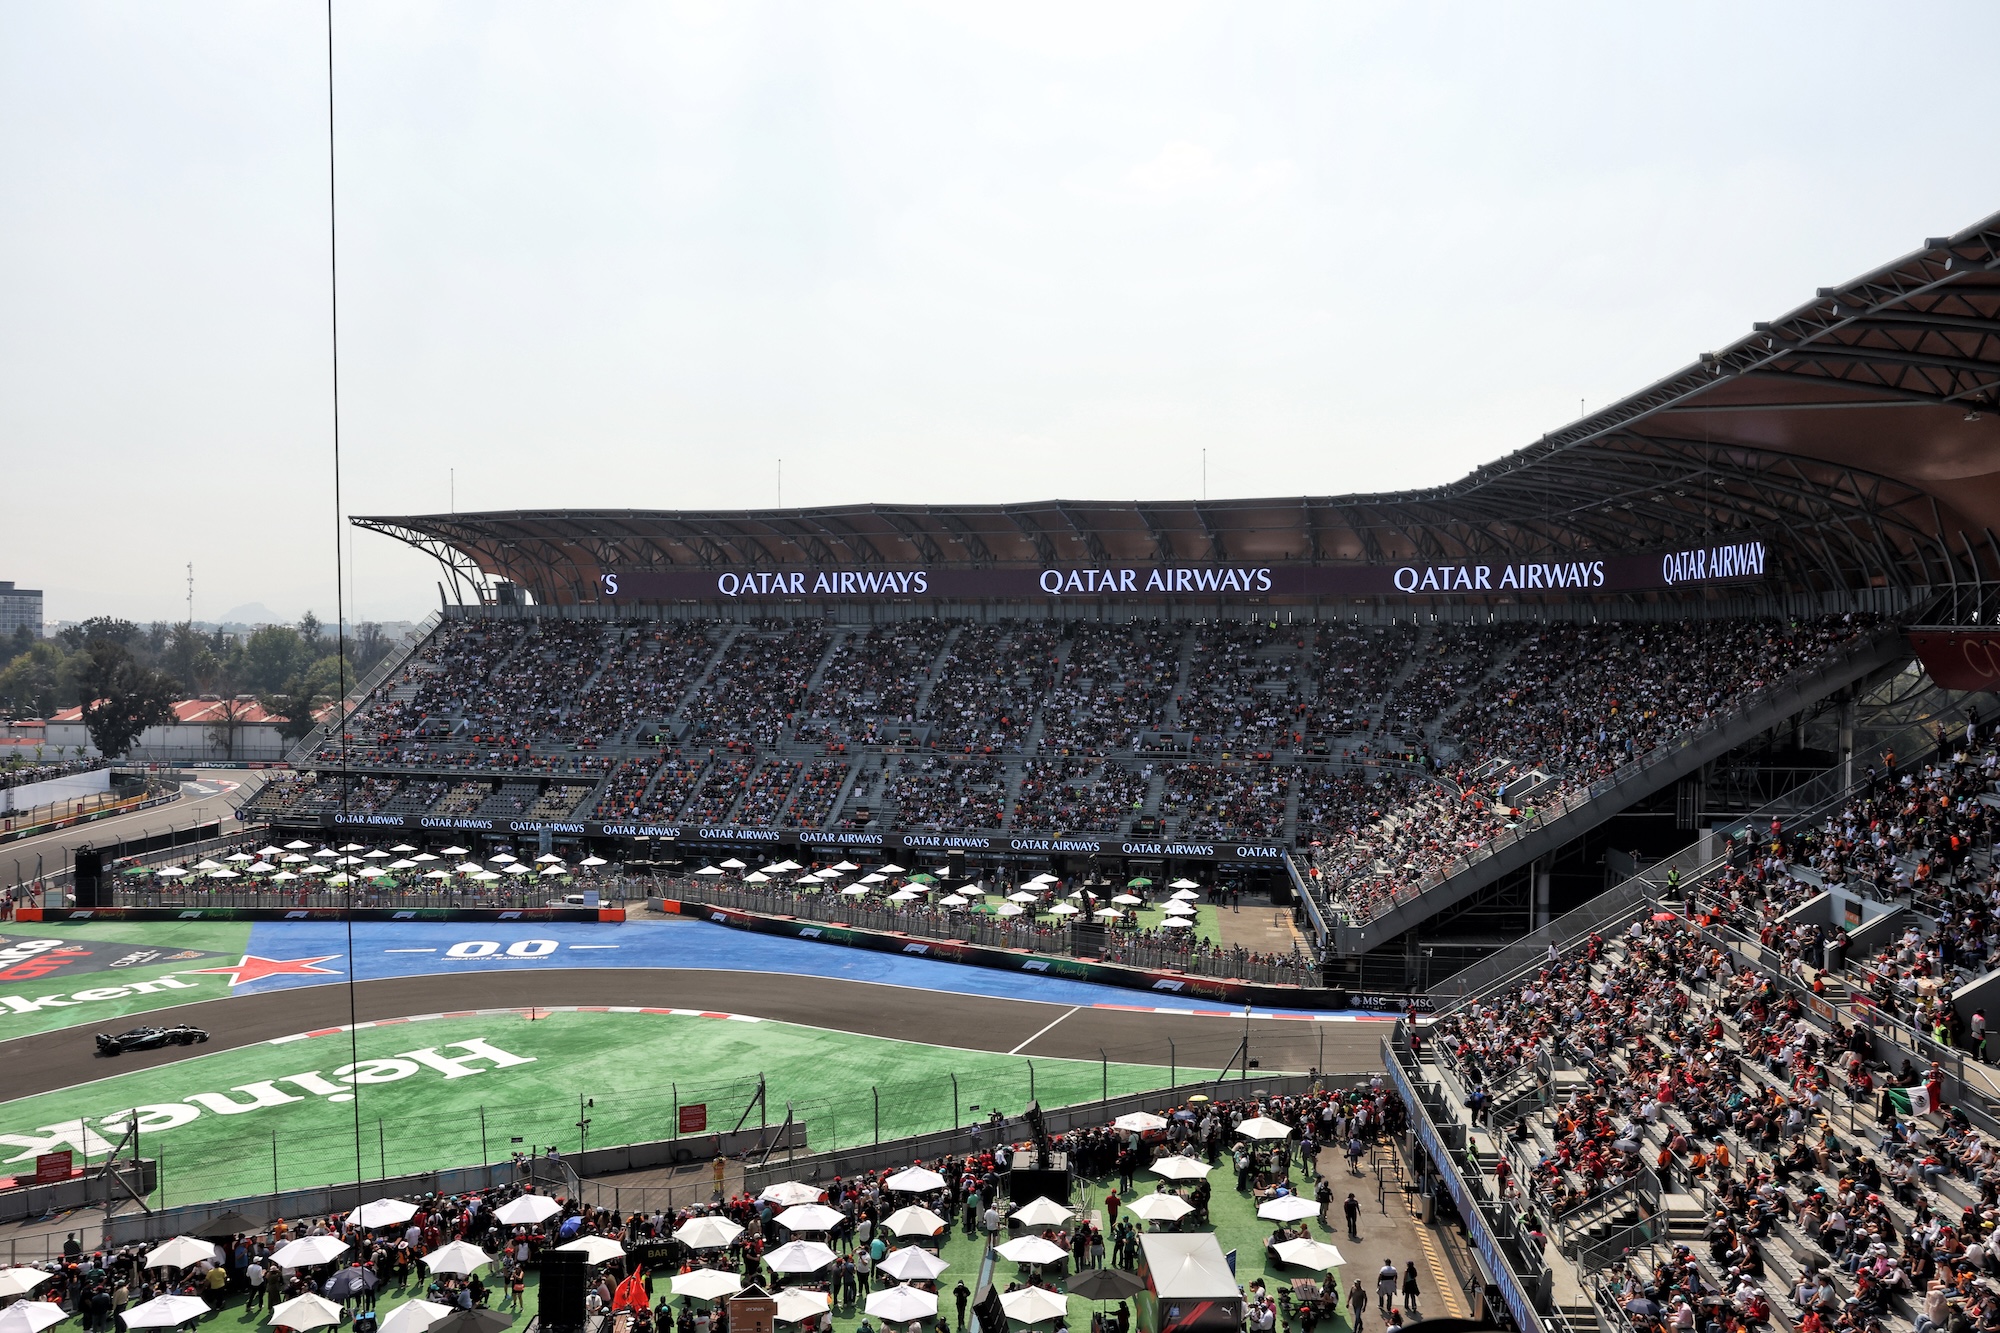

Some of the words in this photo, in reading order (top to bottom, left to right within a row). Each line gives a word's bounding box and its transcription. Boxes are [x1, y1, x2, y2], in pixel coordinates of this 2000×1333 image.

[1663, 549, 1706, 586] QATAR
[1708, 542, 1766, 579] AIRWAY
[1039, 569, 1137, 595] QATAR
[1144, 568, 1272, 592] AIRWAYS
[1393, 565, 1491, 594] QATAR
[1498, 561, 1604, 589] AIRWAYS
[717, 572, 806, 602] QATAR
[812, 571, 927, 594] AIRWAYS
[334, 813, 366, 825] QATAR
[367, 815, 404, 826] AIRWAYS
[420, 817, 453, 828] QATAR
[453, 818, 493, 830] AIRWAYS
[602, 825, 637, 836] QATAR
[638, 826, 681, 837] AIRWAYS
[699, 828, 735, 840] QATAR
[735, 829, 780, 841] AIRWAYS
[799, 831, 836, 843] QATAR
[837, 833, 883, 845] AIRWAYS
[903, 835, 942, 847] QATAR
[942, 836, 990, 849] AIRWAYS
[1010, 838, 1050, 850] QATAR
[1051, 840, 1101, 852] AIRWAYS
[1121, 843, 1163, 855] QATAR
[1164, 844, 1214, 856] AIRWAYS
[1236, 846, 1278, 859] QATAR
[445, 939, 560, 958] 0.0
[0, 975, 199, 1016] ken
[1191, 983, 1213, 995] Mexico
[1215, 983, 1228, 1001] City
[1363, 996, 1386, 1006] MSC
[1410, 998, 1434, 1008] MSC
[647, 1248, 668, 1259] BAR
[1469, 1209, 1492, 1269] QATAR
[1493, 1256, 1526, 1332] AIRWAYS
